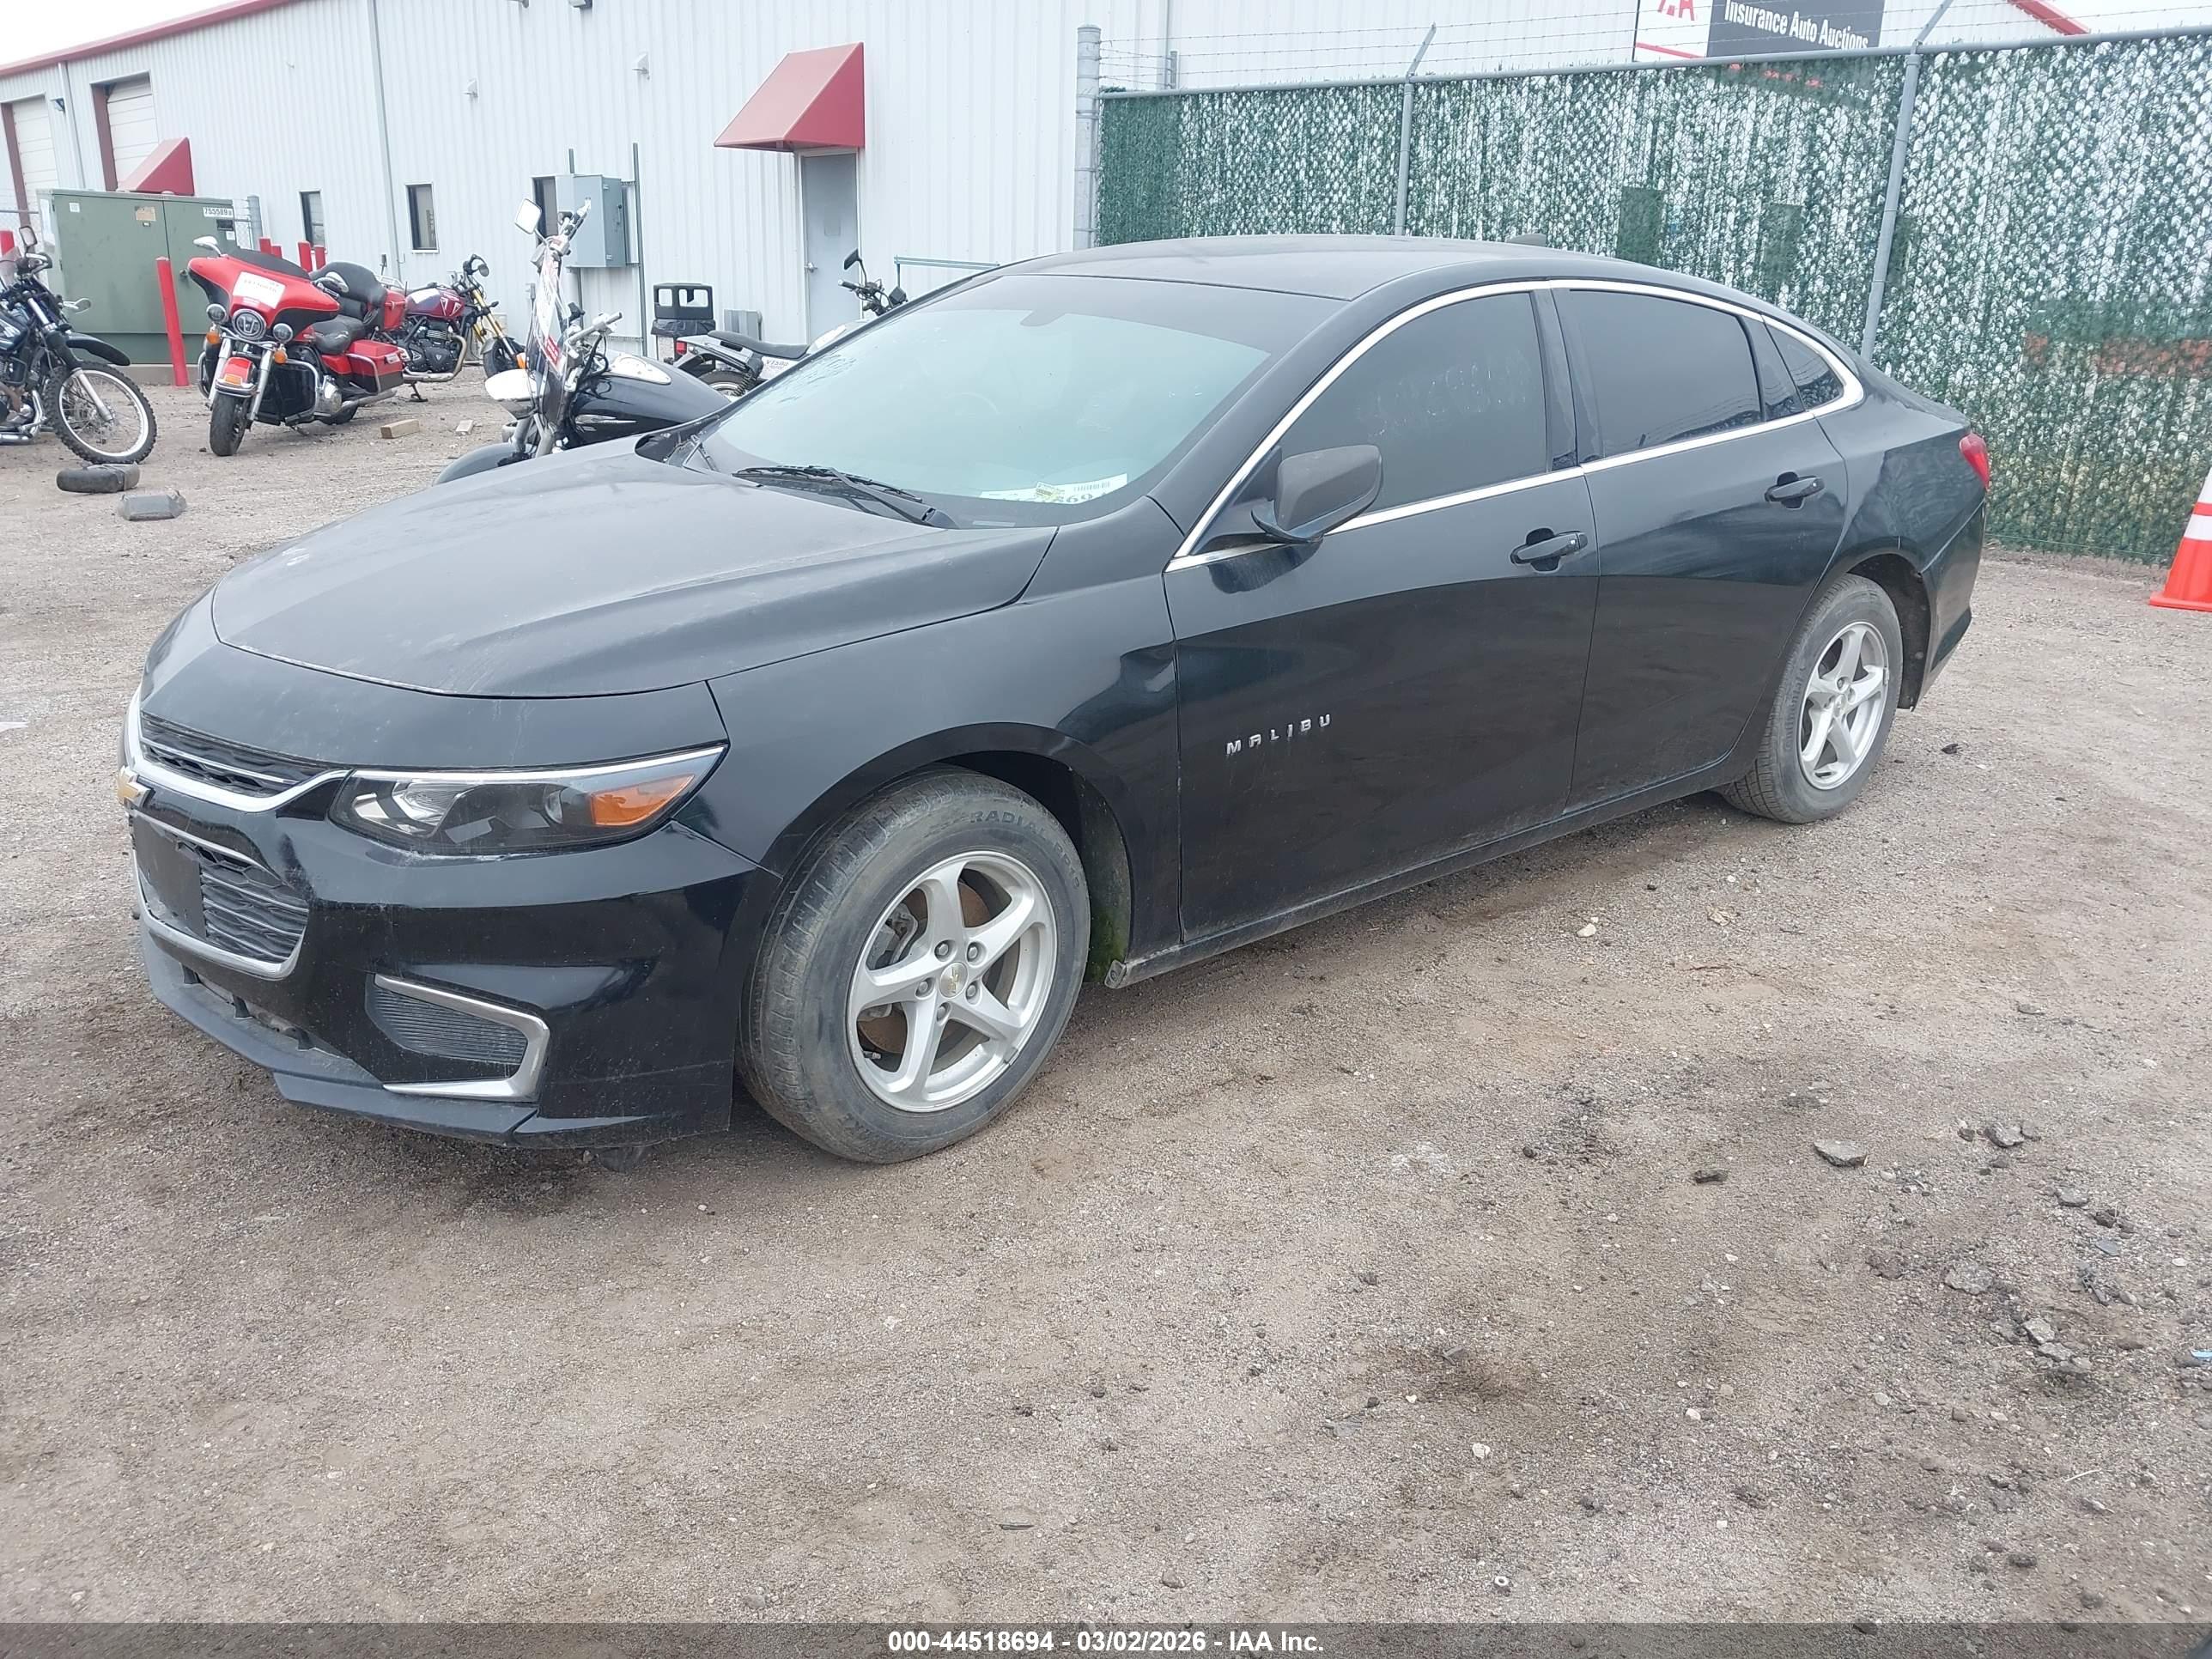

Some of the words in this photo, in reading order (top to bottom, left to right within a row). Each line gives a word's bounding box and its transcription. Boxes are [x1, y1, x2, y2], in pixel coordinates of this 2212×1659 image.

[1724, 0, 1787, 34] Insurance
[1789, 11, 1818, 43] Auto
[1226, 714, 1330, 755] MALIBU
